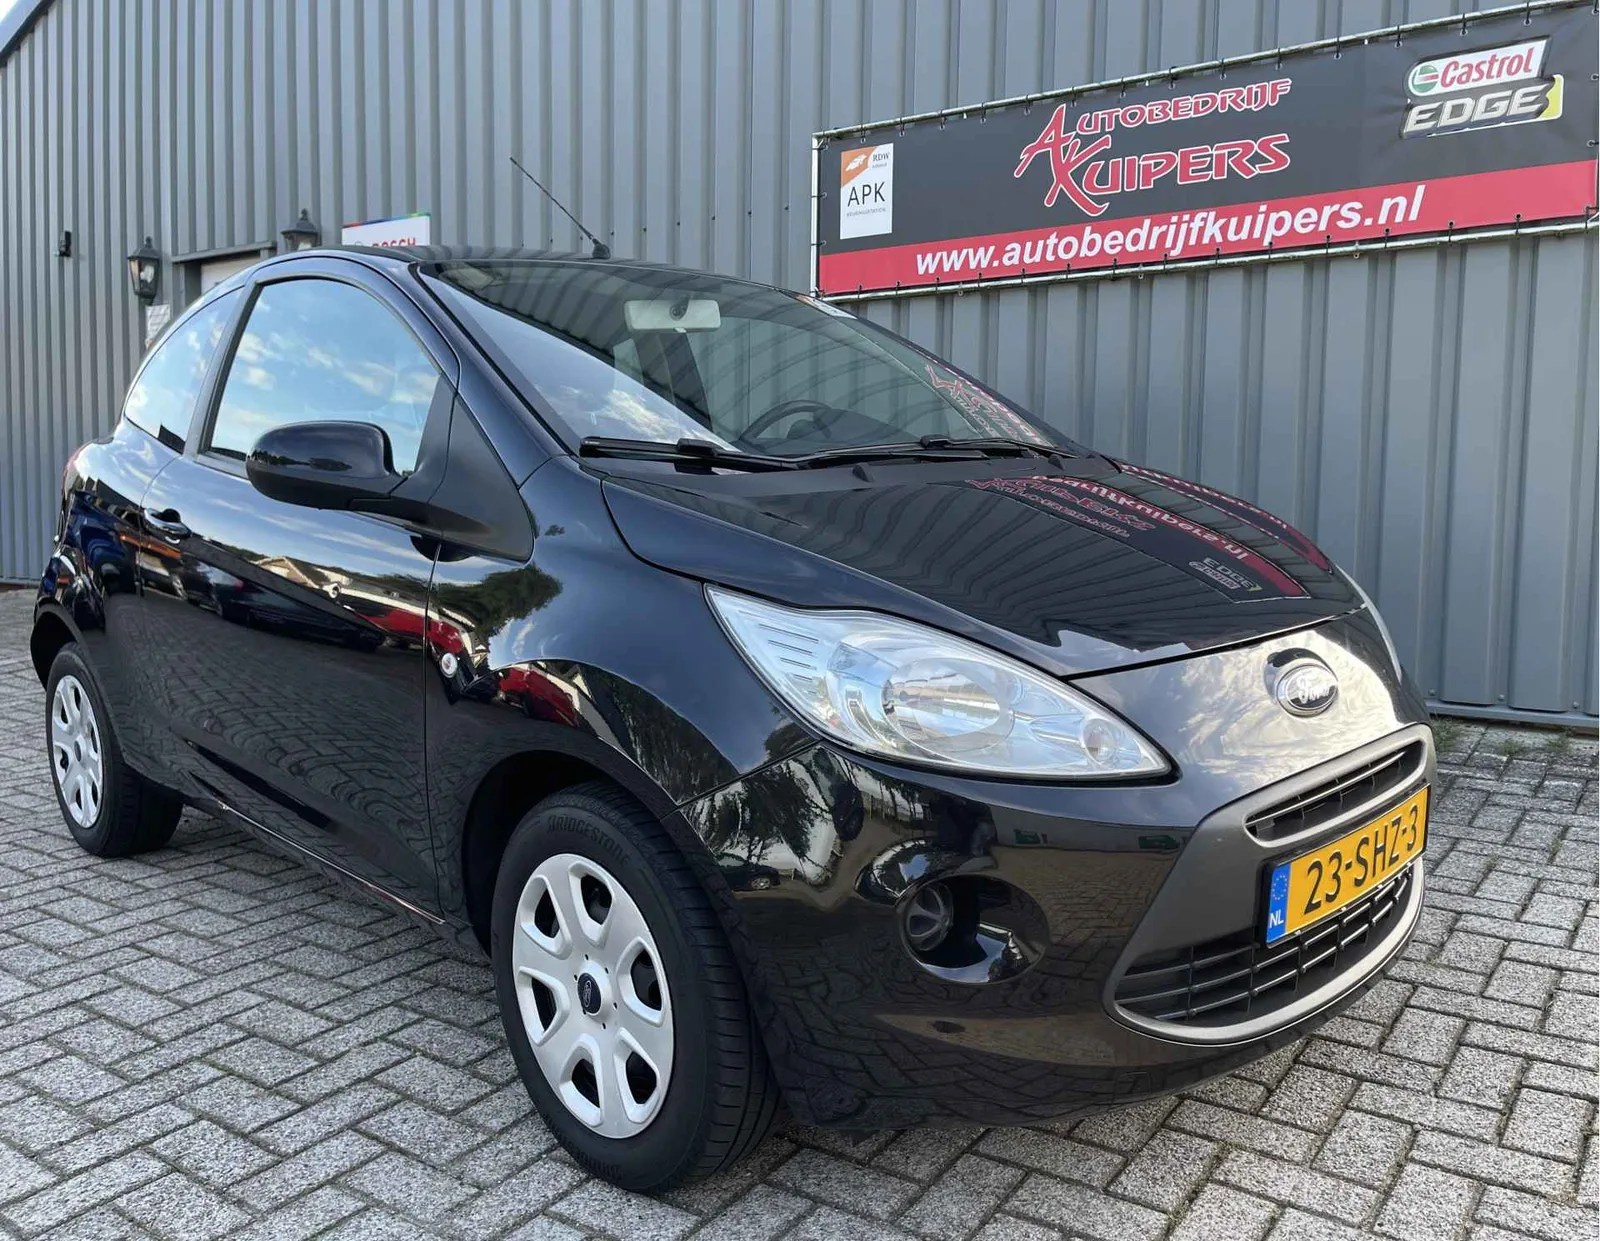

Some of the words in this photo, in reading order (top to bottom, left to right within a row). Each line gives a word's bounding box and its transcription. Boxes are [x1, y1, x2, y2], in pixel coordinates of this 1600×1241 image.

[1440, 47, 1535, 88] Castrol
[1403, 83, 1550, 133] EDGE
[847, 181, 885, 207] APK
[915, 184, 1426, 275] www.autobedrijfkuipers.nl
[547, 814, 631, 867] BRIDGESTONE
[1303, 804, 1418, 916] 23-SHZ-3
[1269, 912, 1285, 929] NL
